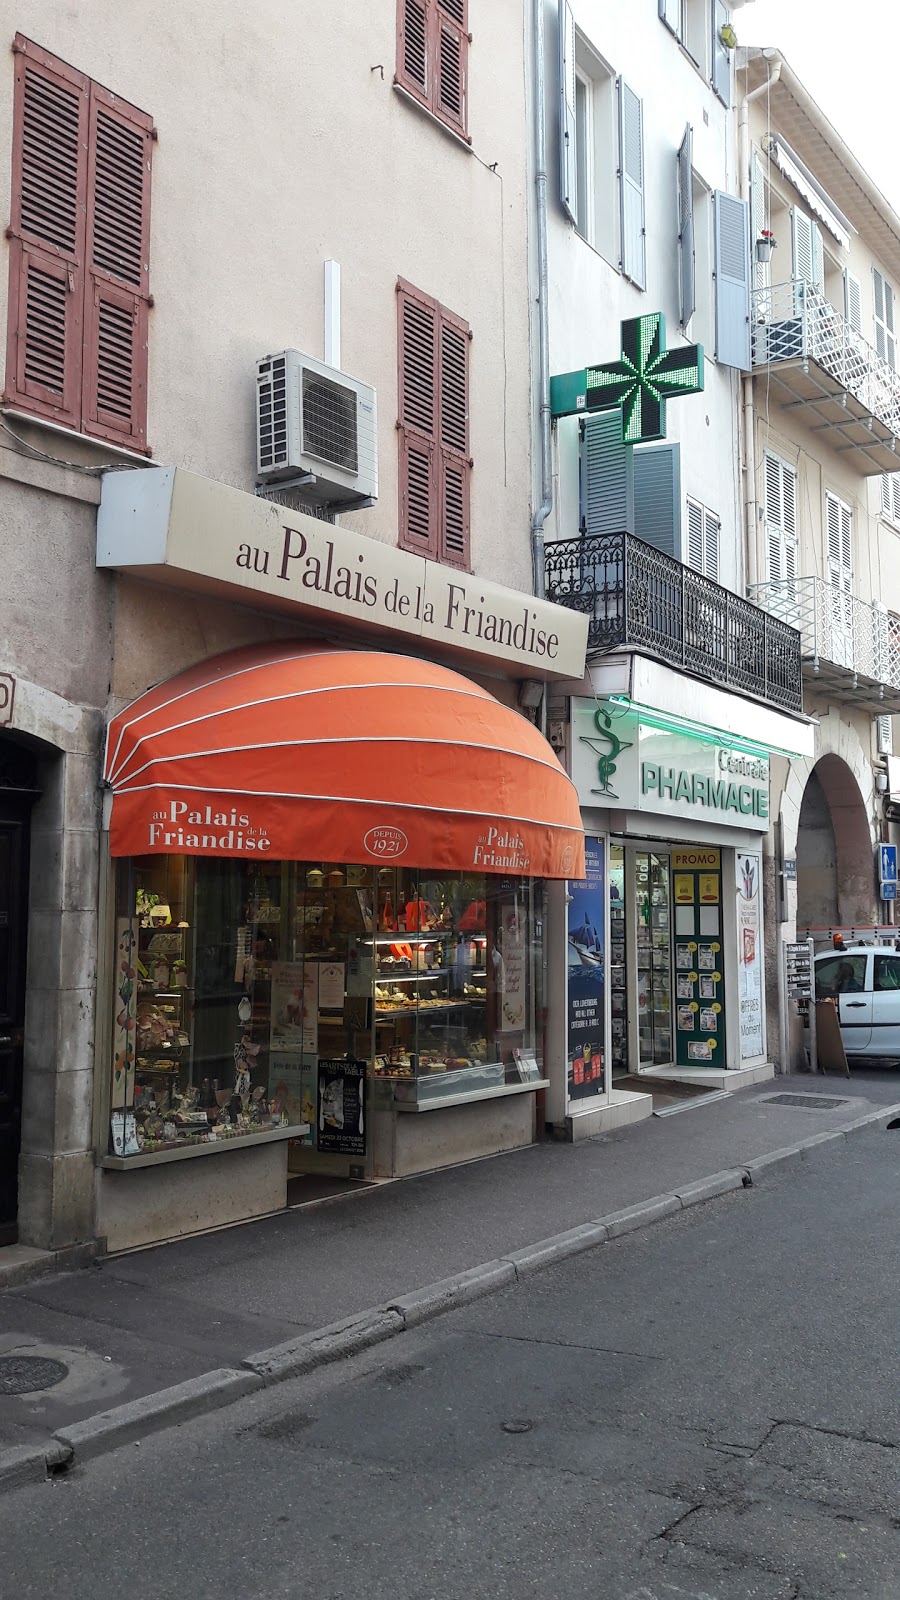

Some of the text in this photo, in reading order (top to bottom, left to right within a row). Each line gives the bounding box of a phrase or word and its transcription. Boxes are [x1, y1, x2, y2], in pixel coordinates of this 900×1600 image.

[235, 525, 560, 659] au Palais de la Friandise
[719, 749, 769, 781] Centrale
[642, 761, 769, 818] PHARMACIE
[152, 800, 250, 828] au Palais
[148, 822, 271, 851] Friandise
[246, 827, 267, 836] de la
[373, 829, 402, 841] DEPUIS
[477, 826, 524, 850] au Palais
[372, 839, 401, 854] 1921
[472, 845, 530, 870] Friandise
[675, 854, 716, 864] PROMO
[740, 1022, 761, 1036] Moment
[328, 1062, 344, 1071] ARTS
[344, 1068, 364, 1076] TABLE
[342, 1135, 364, 1143] OCTOBRE
